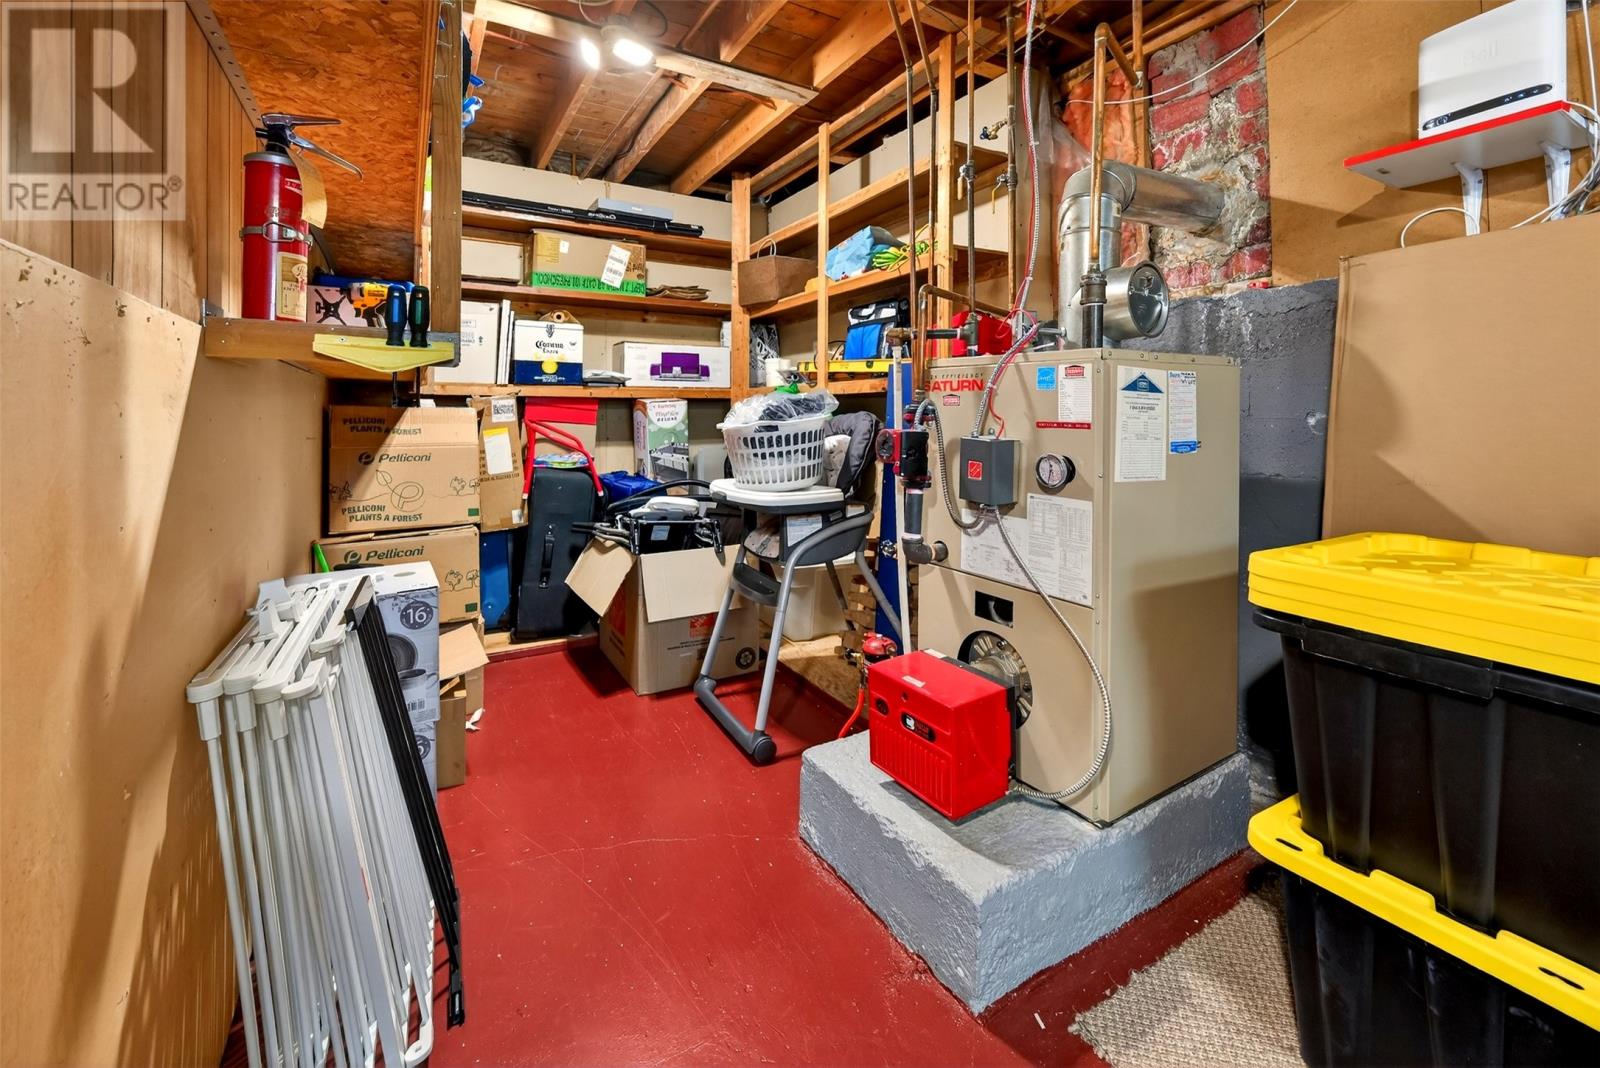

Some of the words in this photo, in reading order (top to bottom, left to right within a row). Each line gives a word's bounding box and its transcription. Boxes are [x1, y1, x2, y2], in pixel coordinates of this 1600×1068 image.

[924, 379, 984, 392] SATURN
[343, 417, 385, 425] PELLICONI
[392, 427, 422, 436] FOREST
[378, 452, 432, 463] Pelliconi
[341, 504, 386, 514] PELLICONI
[349, 513, 382, 522] PLANTS
[392, 513, 423, 522] FOREST
[365, 545, 425, 561] Pelliconi
[406, 606, 428, 624] 16
